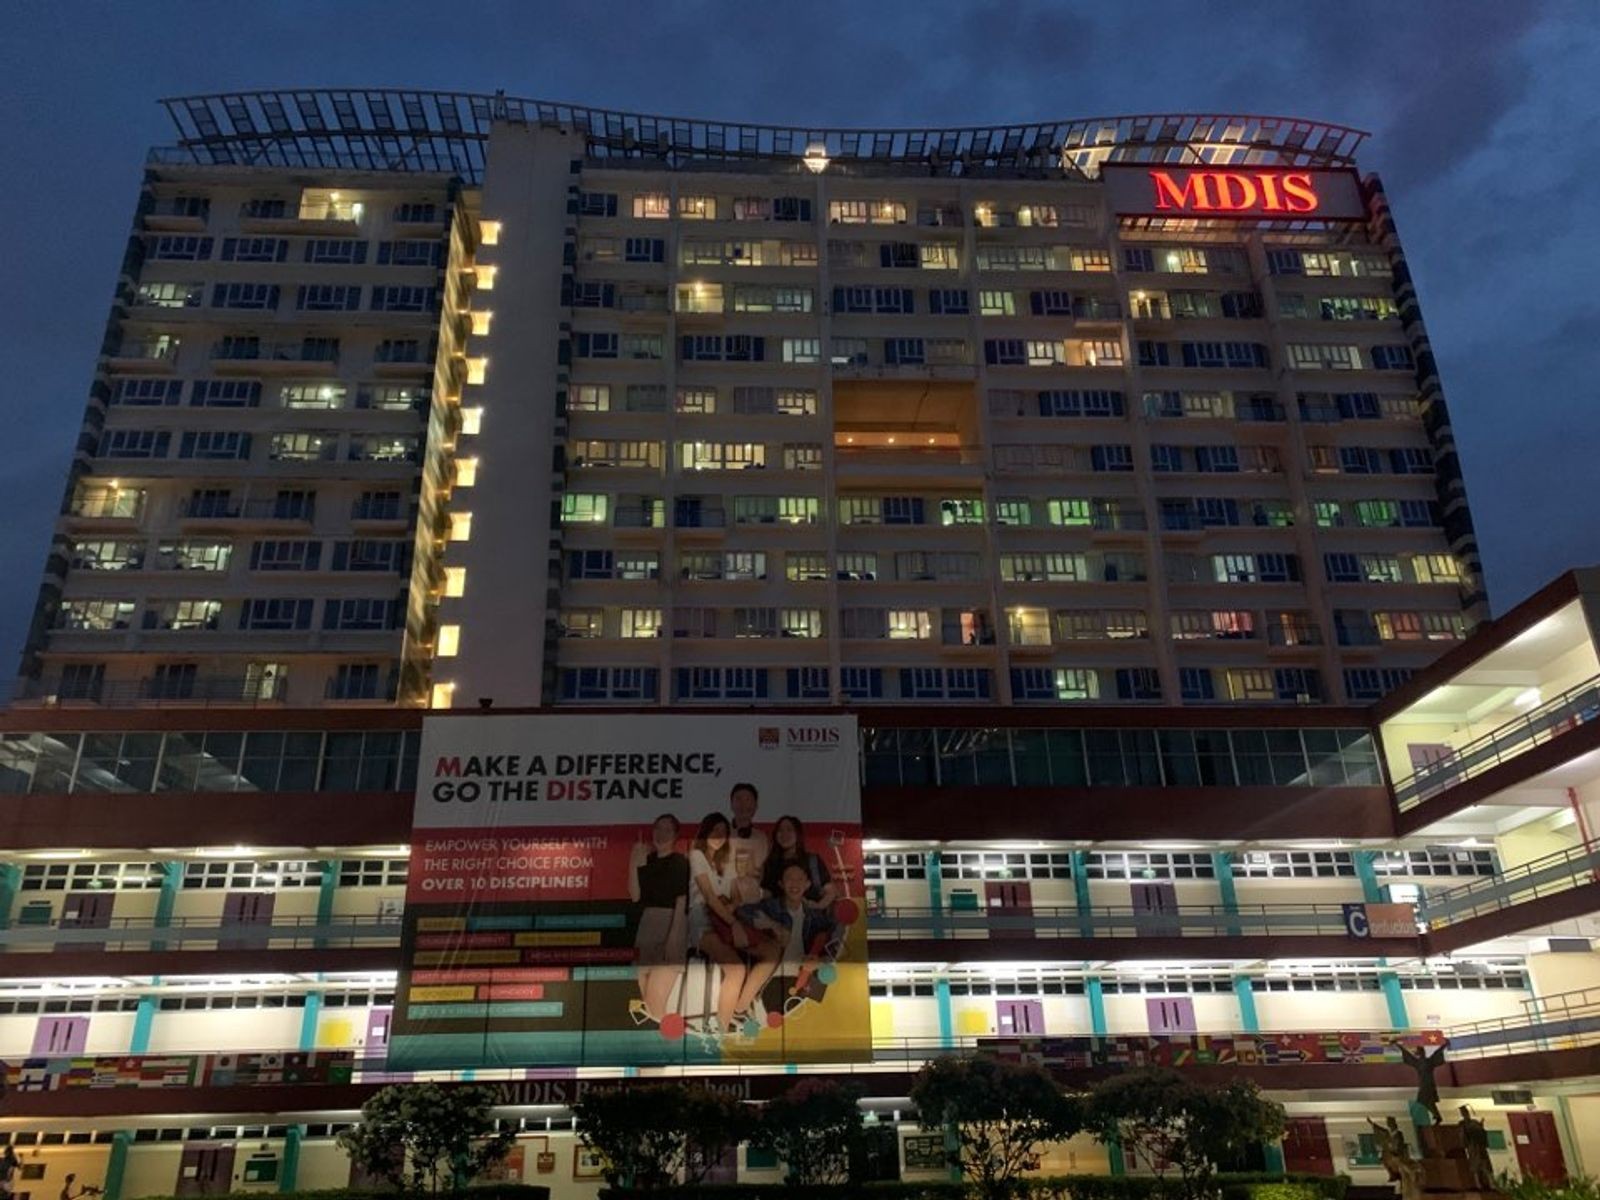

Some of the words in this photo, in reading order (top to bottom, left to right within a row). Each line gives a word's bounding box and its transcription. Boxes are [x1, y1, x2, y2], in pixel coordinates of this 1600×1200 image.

[1149, 170, 1319, 212] MDIS
[787, 728, 839, 743] MDIS
[434, 754, 519, 777] MAKE
[527, 755, 548, 776] A
[556, 753, 722, 777] DIFFERENCE,
[432, 781, 481, 803] GO
[488, 780, 538, 802] THE
[546, 778, 683, 802] DISTANCE
[425, 838, 498, 853] EMPOWER
[501, 837, 569, 852] YOURSELF
[571, 836, 608, 849] WITH
[424, 857, 449, 871] THE
[451, 856, 494, 870] RIGHT
[497, 856, 551, 870] CHOICE
[553, 855, 594, 869] FROM
[421, 877, 464, 891] OVER
[470, 876, 484, 890] 10
[489, 875, 589, 890] DISCIPLINES!
[1349, 911, 1368, 937] C
[498, 1081, 567, 1105] MDIS
